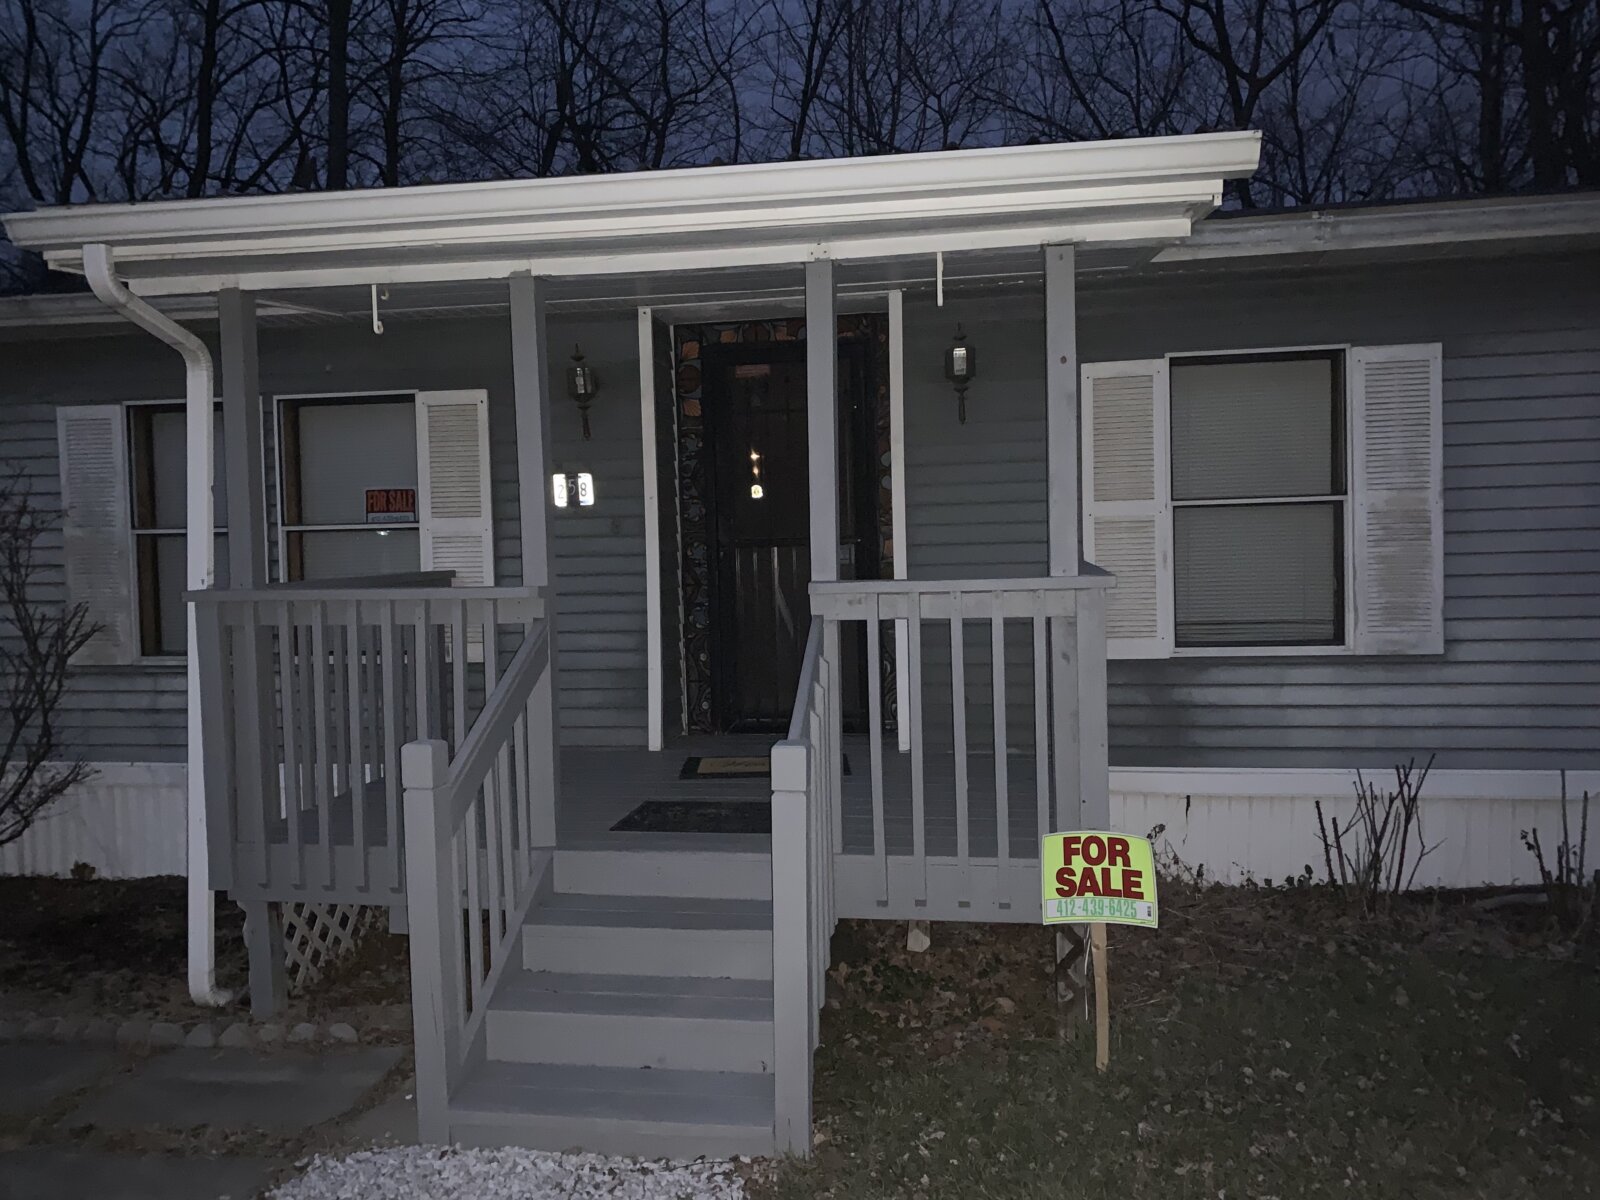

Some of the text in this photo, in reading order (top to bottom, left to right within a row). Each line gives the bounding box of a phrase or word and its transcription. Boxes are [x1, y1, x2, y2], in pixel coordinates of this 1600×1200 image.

[558, 479, 587, 499] 258
[368, 490, 414, 512] FOR SALE
[1063, 835, 1131, 868] FOR
[1055, 867, 1144, 900] SALE
[1056, 899, 1137, 918] 412-439-6425
